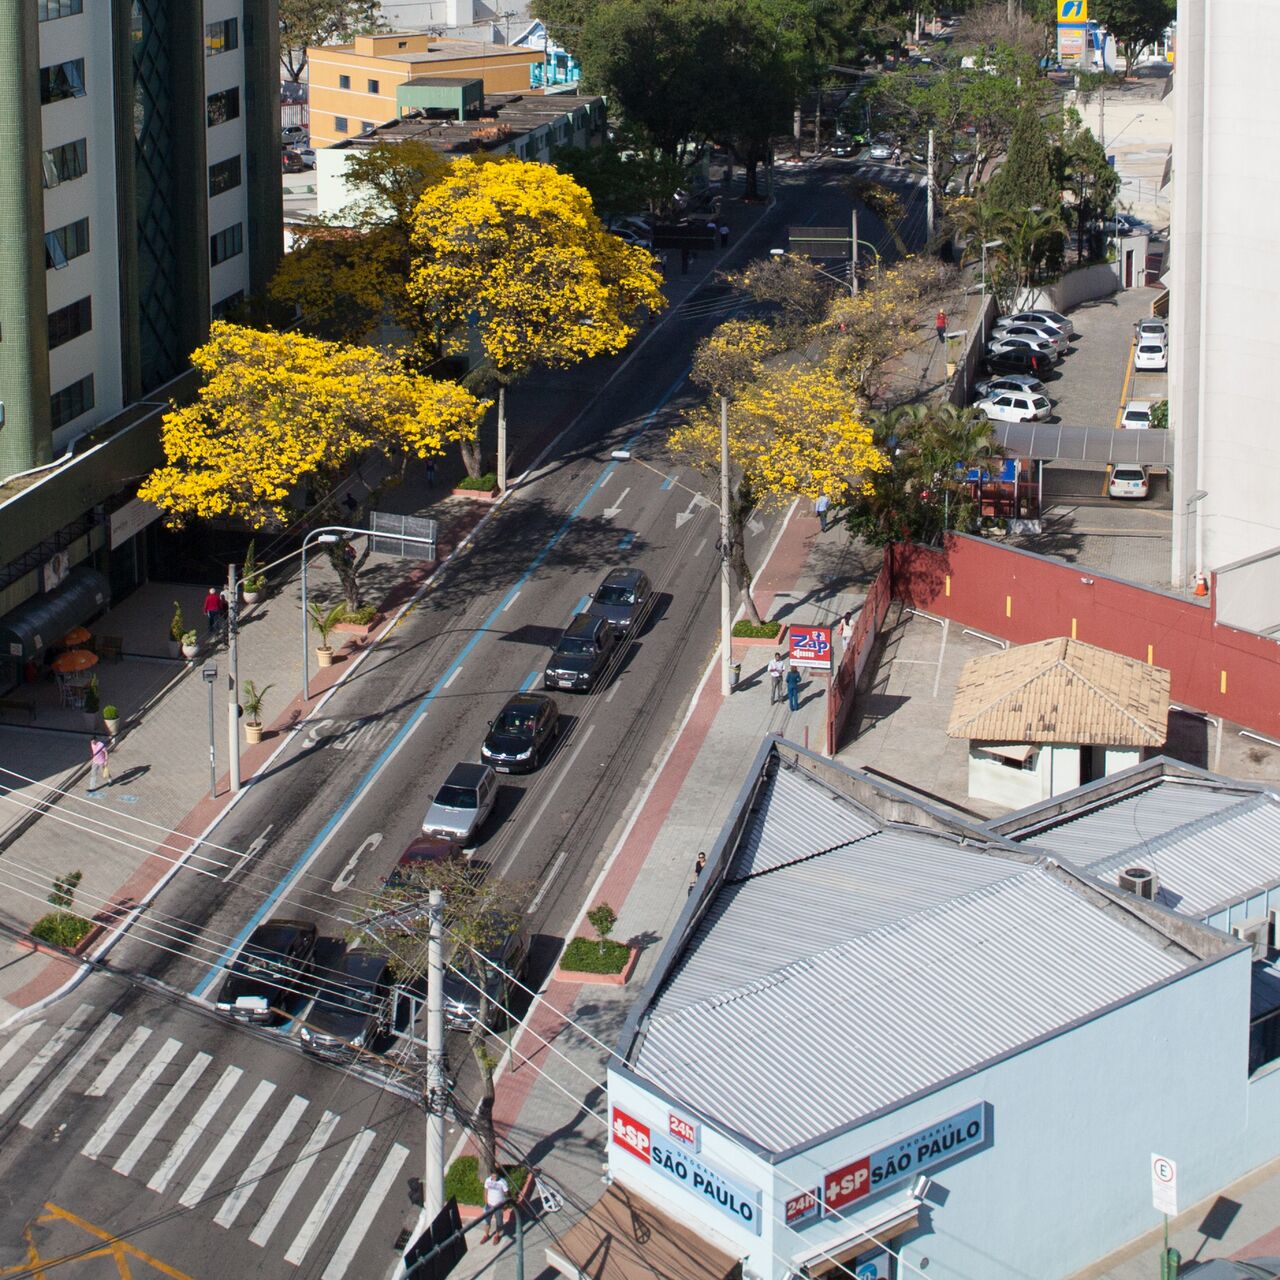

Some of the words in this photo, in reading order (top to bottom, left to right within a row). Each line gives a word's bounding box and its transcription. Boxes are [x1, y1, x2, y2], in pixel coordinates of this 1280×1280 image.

[791, 633, 829, 655] Zap
[670, 1117, 694, 1143] 24h
[900, 1124, 952, 1151] DROGARIA
[871, 1155, 911, 1184] SÃO
[917, 1120, 980, 1163] PAULO
[652, 1146, 688, 1180] SÃO
[693, 1171, 753, 1221] PAULO
[1160, 1164, 1167, 1177] E
[787, 1192, 816, 1216] 24h
